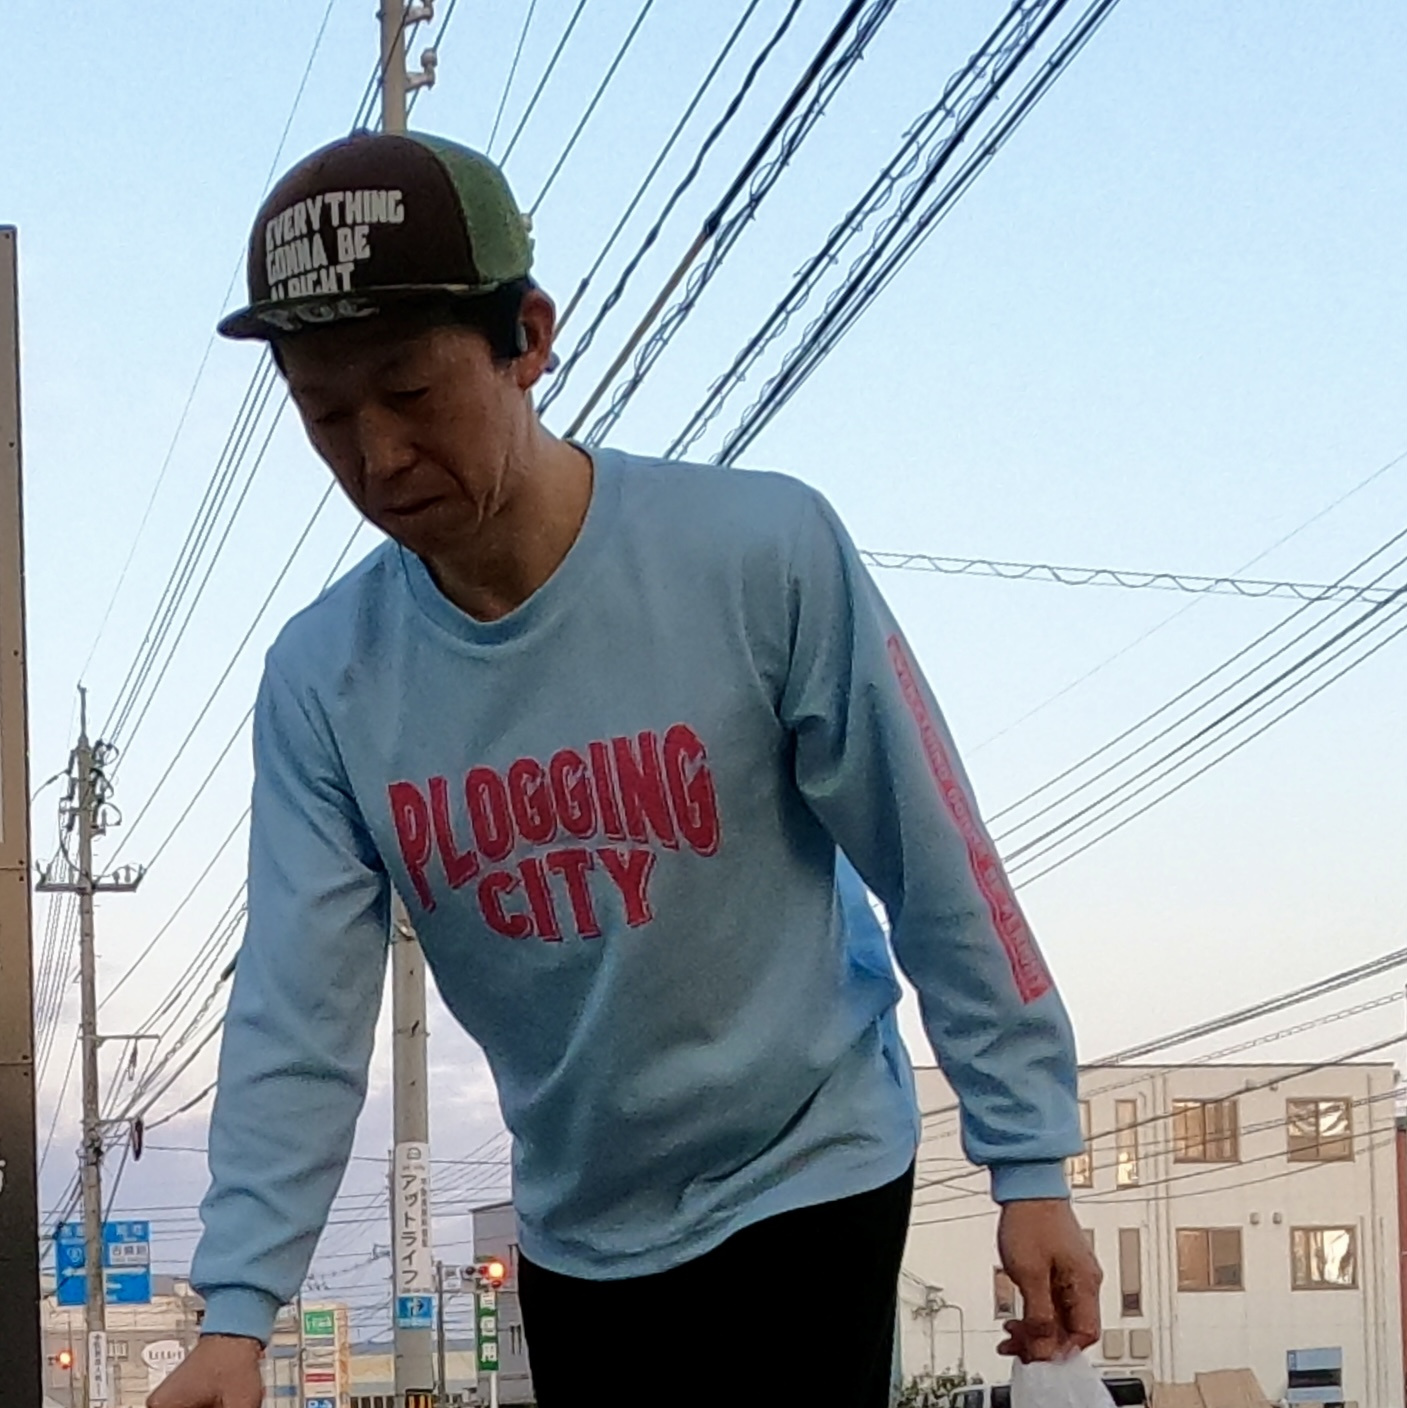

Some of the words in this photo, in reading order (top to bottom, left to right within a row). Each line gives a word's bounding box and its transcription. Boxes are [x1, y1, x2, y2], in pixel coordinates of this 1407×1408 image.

[265, 189, 405, 251] EVERYTHING
[266, 234, 329, 286] GONNA
[337, 225, 371, 261] BE
[388, 722, 722, 912] PLOGGING
[476, 848, 659, 942] CITY
[401, 1175, 419, 1284] アットライフ
